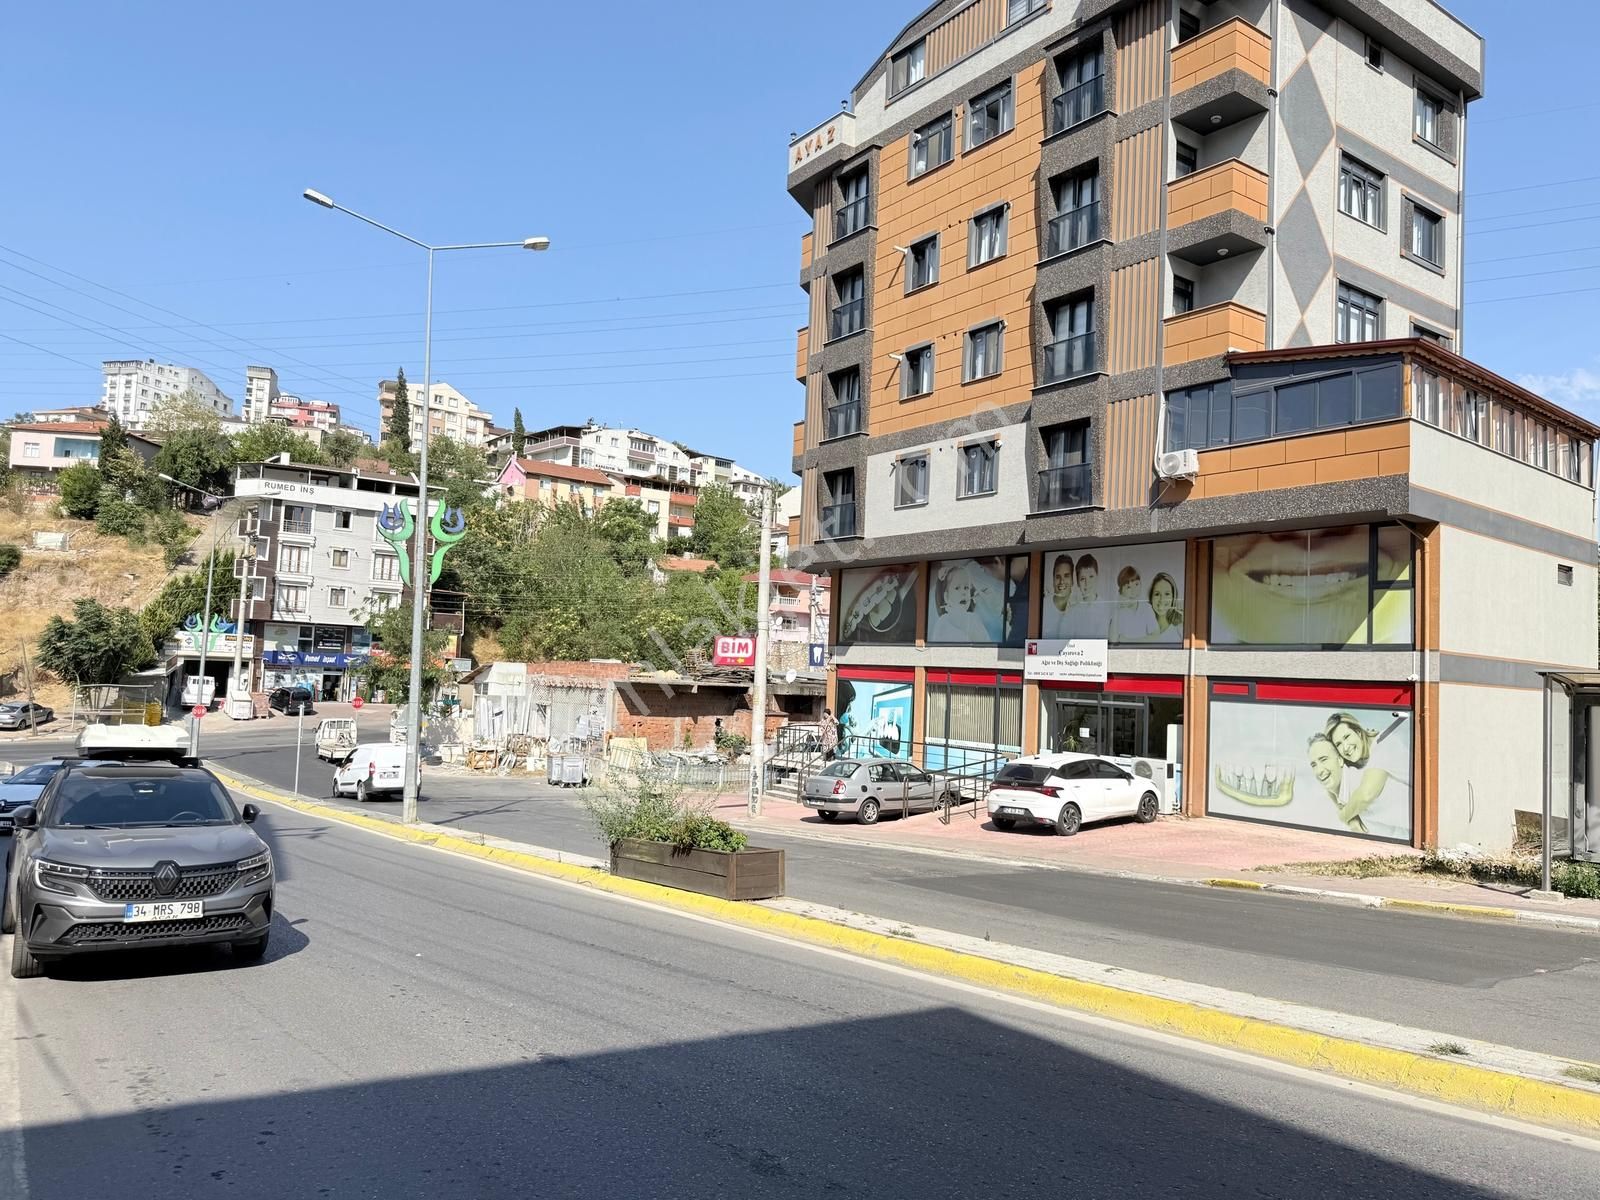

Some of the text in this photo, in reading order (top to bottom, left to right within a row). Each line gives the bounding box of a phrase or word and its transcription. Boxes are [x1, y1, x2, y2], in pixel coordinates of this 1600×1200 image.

[795, 134, 823, 165] AYA
[264, 481, 296, 492] RUMED
[721, 638, 749, 654] BİM
[133, 902, 200, 917] 34 MRS 798
